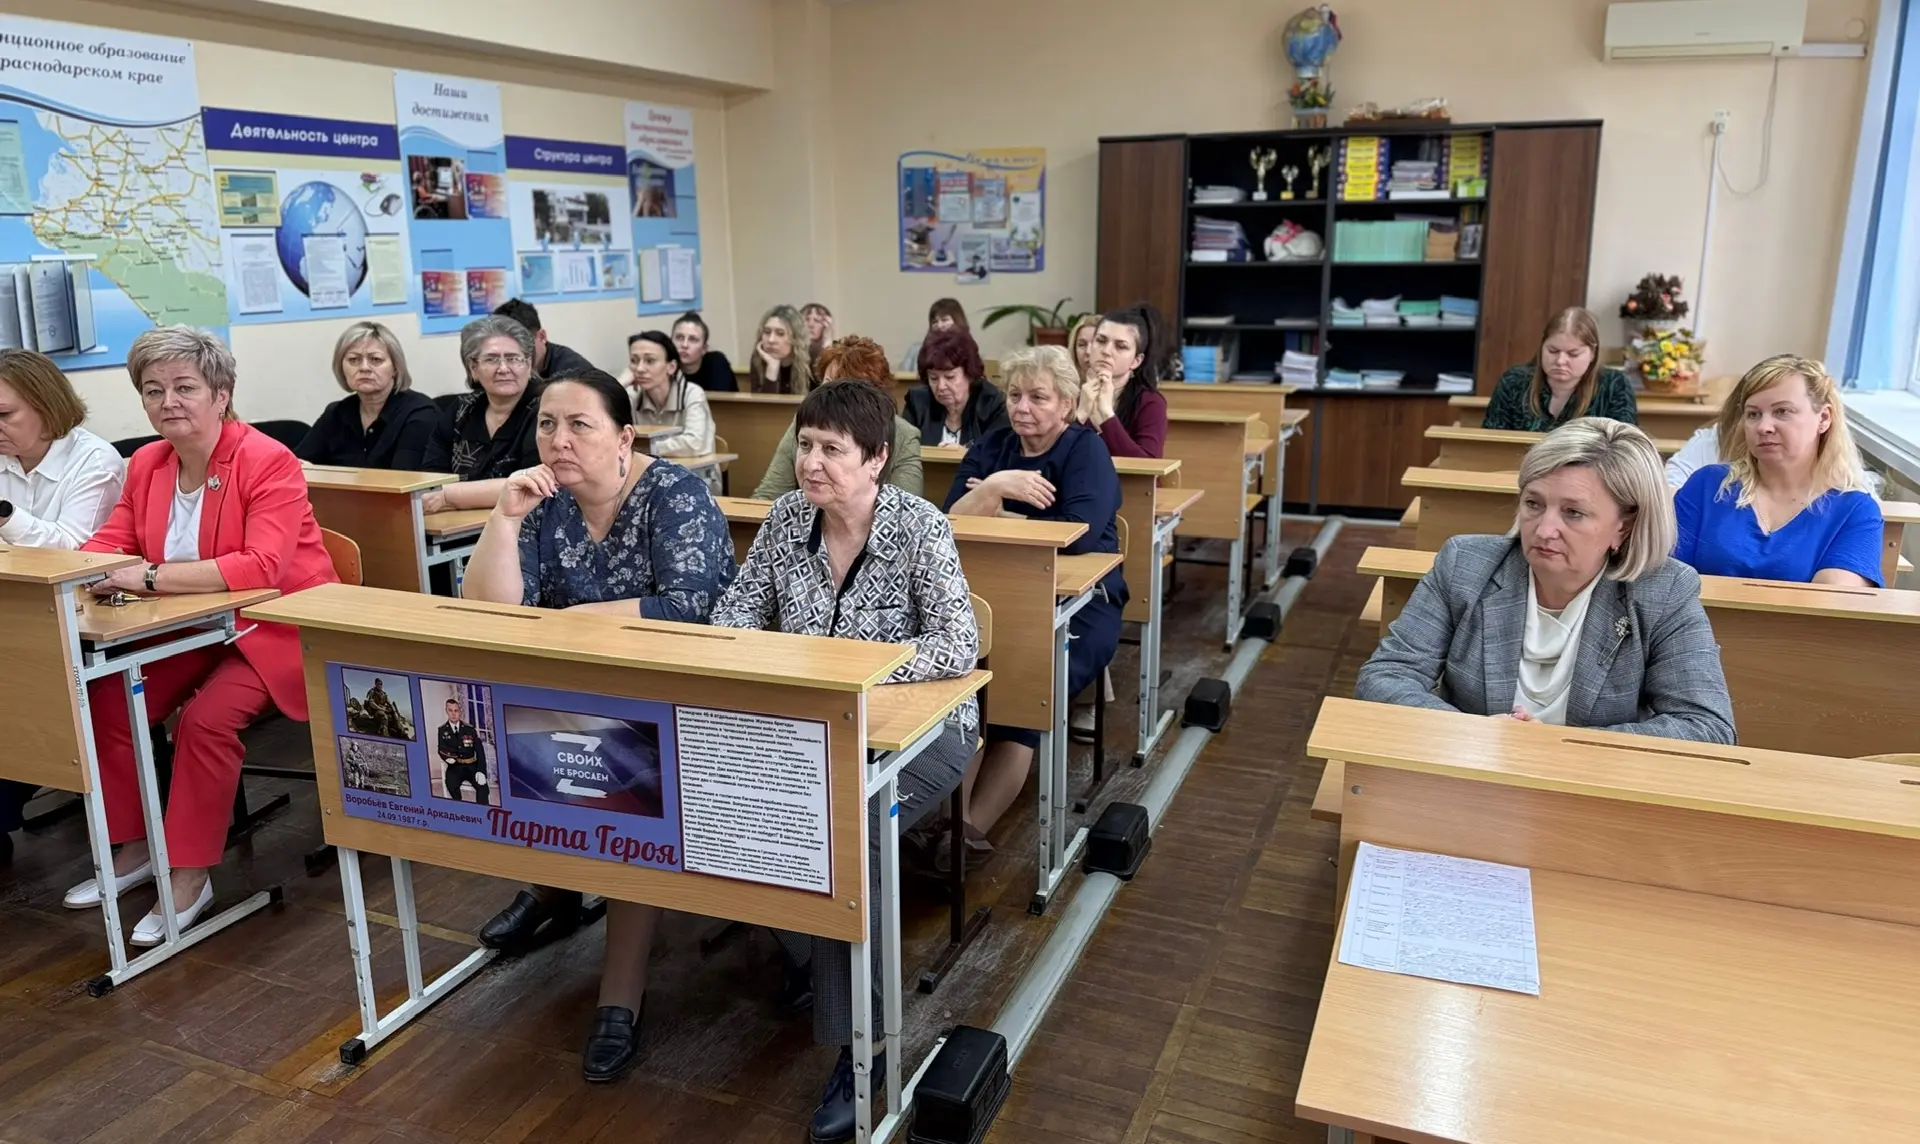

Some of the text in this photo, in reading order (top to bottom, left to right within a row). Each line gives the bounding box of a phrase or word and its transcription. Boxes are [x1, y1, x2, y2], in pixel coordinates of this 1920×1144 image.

[88, 43, 186, 64] образование
[0, 57, 163, 85] раснодарском крае
[433, 82, 467, 99] Наши
[411, 101, 489, 122] достижения
[230, 122, 379, 148] Деятельность центра
[556, 751, 604, 768] СВОИХ
[553, 766, 609, 783] НЕ БРОСАЕМ
[376, 810, 416, 824] 24.09.1987
[389, 801, 425, 815] Евгений
[427, 808, 483, 825] Аркадьевич
[487, 808, 591, 851] Парта
[595, 824, 679, 866] Героя
